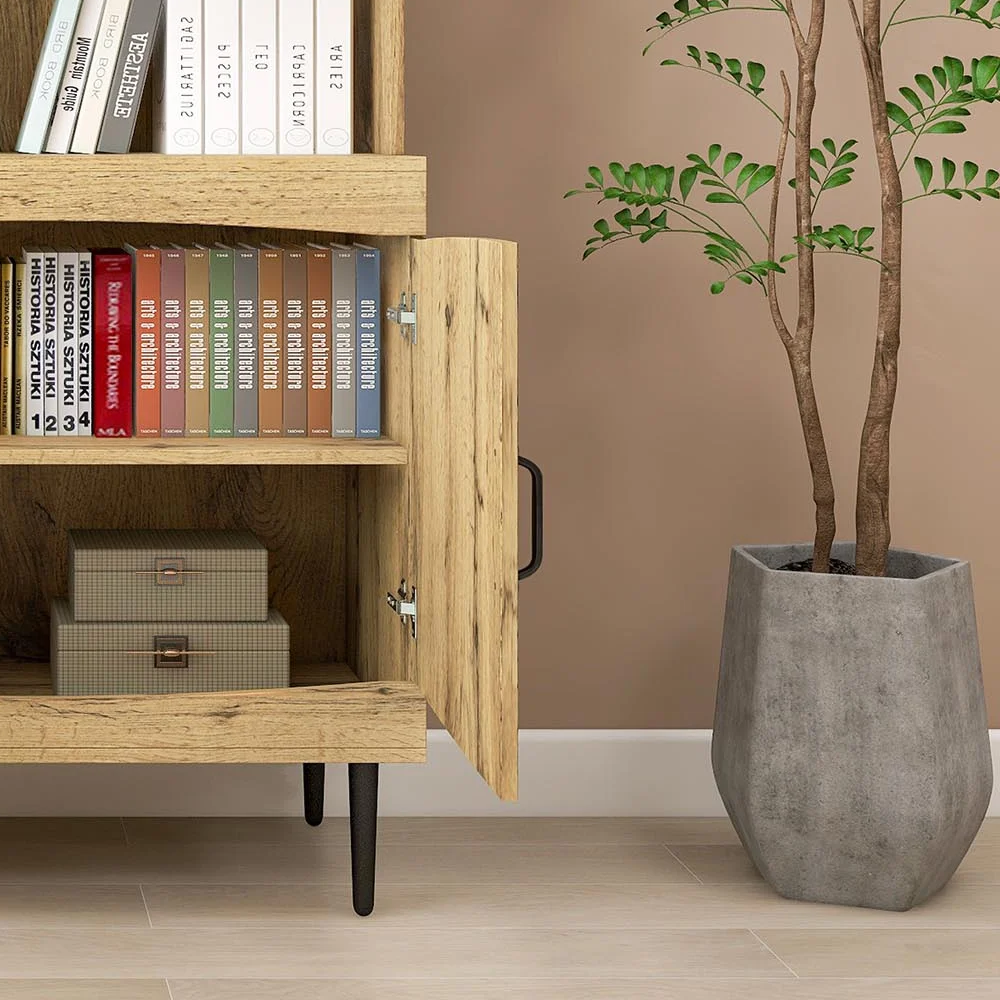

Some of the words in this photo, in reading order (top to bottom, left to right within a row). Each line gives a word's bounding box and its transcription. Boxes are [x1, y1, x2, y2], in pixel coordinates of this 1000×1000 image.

[31, 258, 41, 335] HISTORIA
[45, 256, 56, 333] HISTORIA
[63, 264, 75, 341] HISTORIA
[80, 260, 90, 337] HISTORIA
[140, 299, 155, 318] arts
[214, 299, 229, 318] arts
[361, 299, 376, 318] arts
[31, 339, 41, 399] SZTUKI
[45, 338, 56, 398] SZTUKI
[63, 345, 75, 405] SZTUKI
[80, 342, 90, 401] SZTUKI
[140, 332, 158, 389] architecture
[214, 332, 232, 389] architecture
[361, 332, 379, 389] architecture
[32, 413, 40, 429] 1
[46, 415, 57, 431] 2
[63, 415, 75, 431] 3
[79, 411, 90, 427] 4
